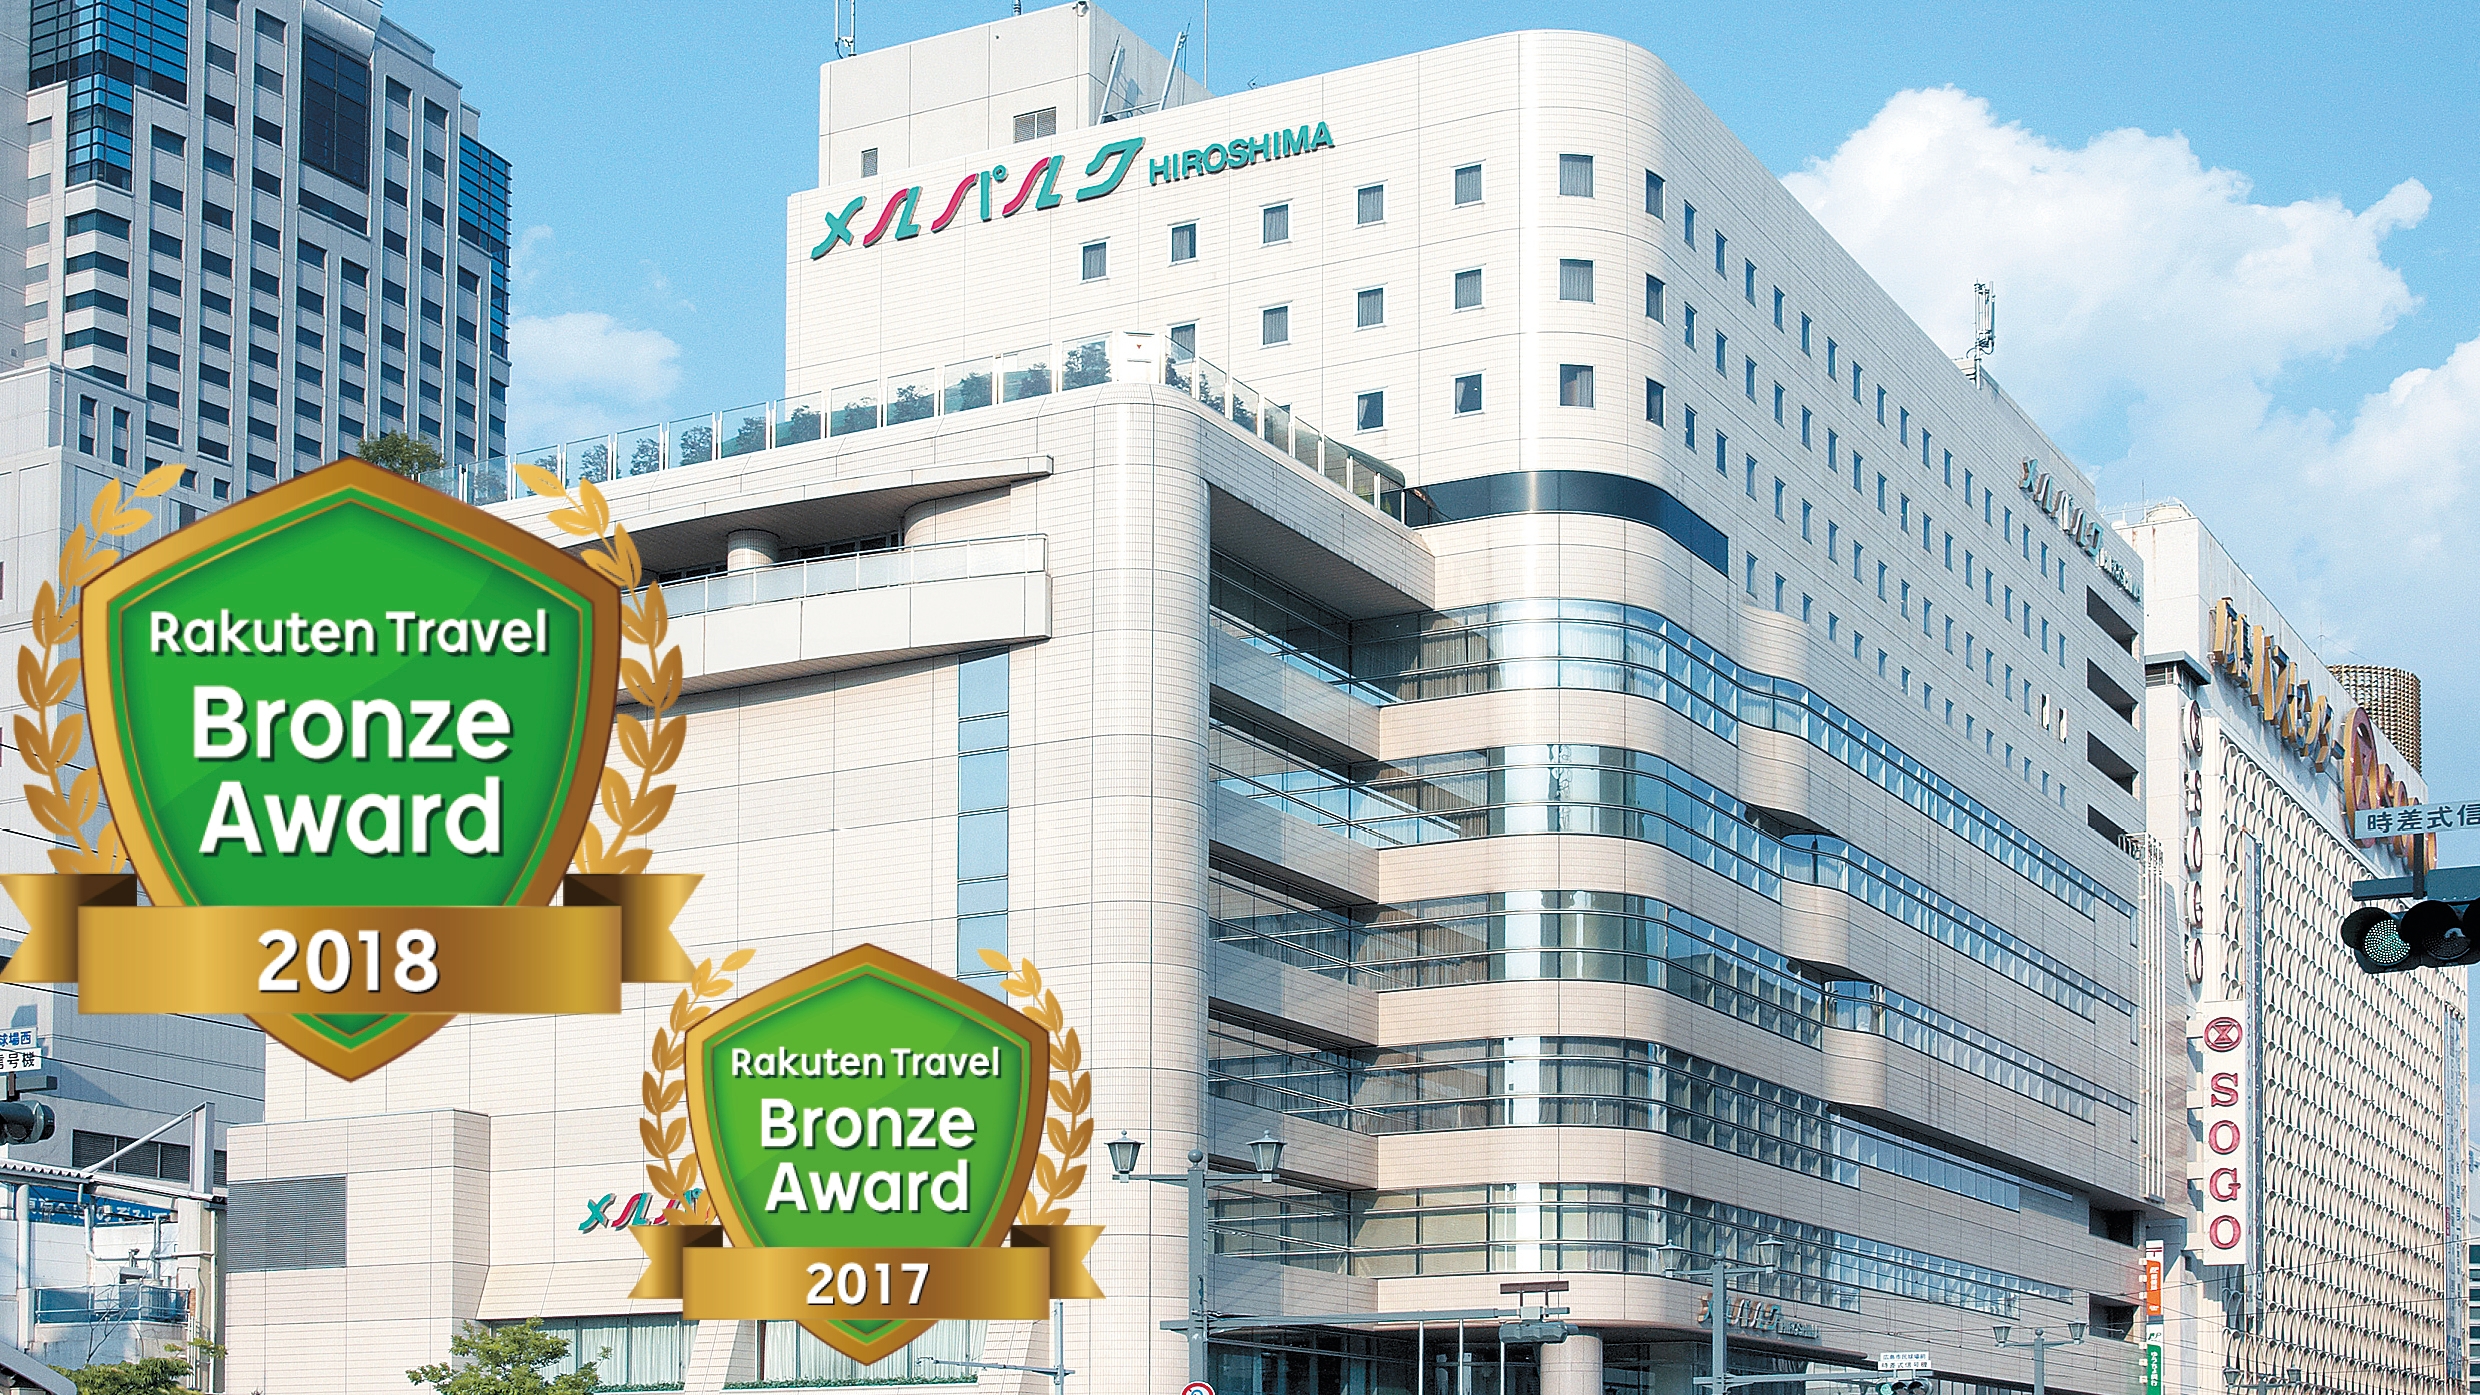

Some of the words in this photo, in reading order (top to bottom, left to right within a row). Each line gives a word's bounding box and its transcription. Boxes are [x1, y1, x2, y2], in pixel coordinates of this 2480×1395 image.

[810, 135, 1146, 260] メルパルク
[1149, 121, 1335, 186] HIROSHIMA
[2208, 1071, 2242, 1250] SOGO
